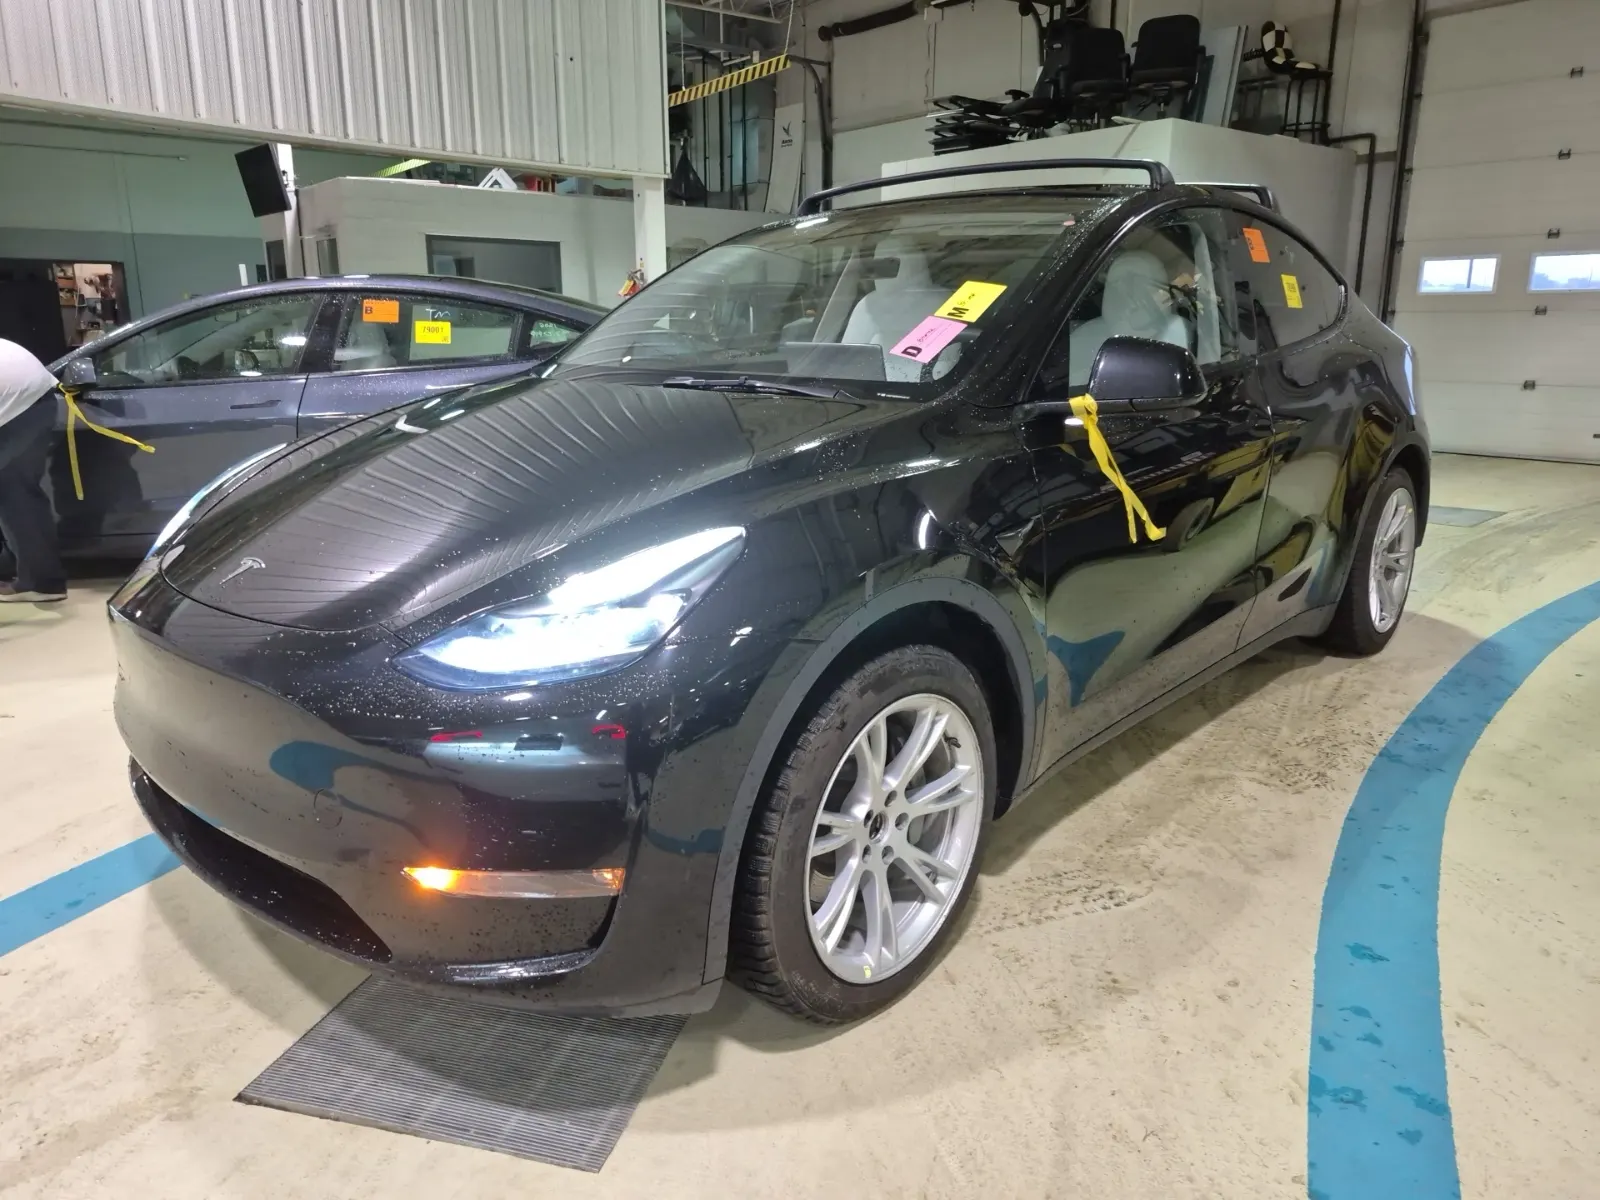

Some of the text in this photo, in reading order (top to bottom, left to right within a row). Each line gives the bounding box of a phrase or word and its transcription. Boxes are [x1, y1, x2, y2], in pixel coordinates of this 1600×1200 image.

[365, 306, 373, 315] B
[947, 306, 970, 318] M
[901, 345, 923, 358] D
